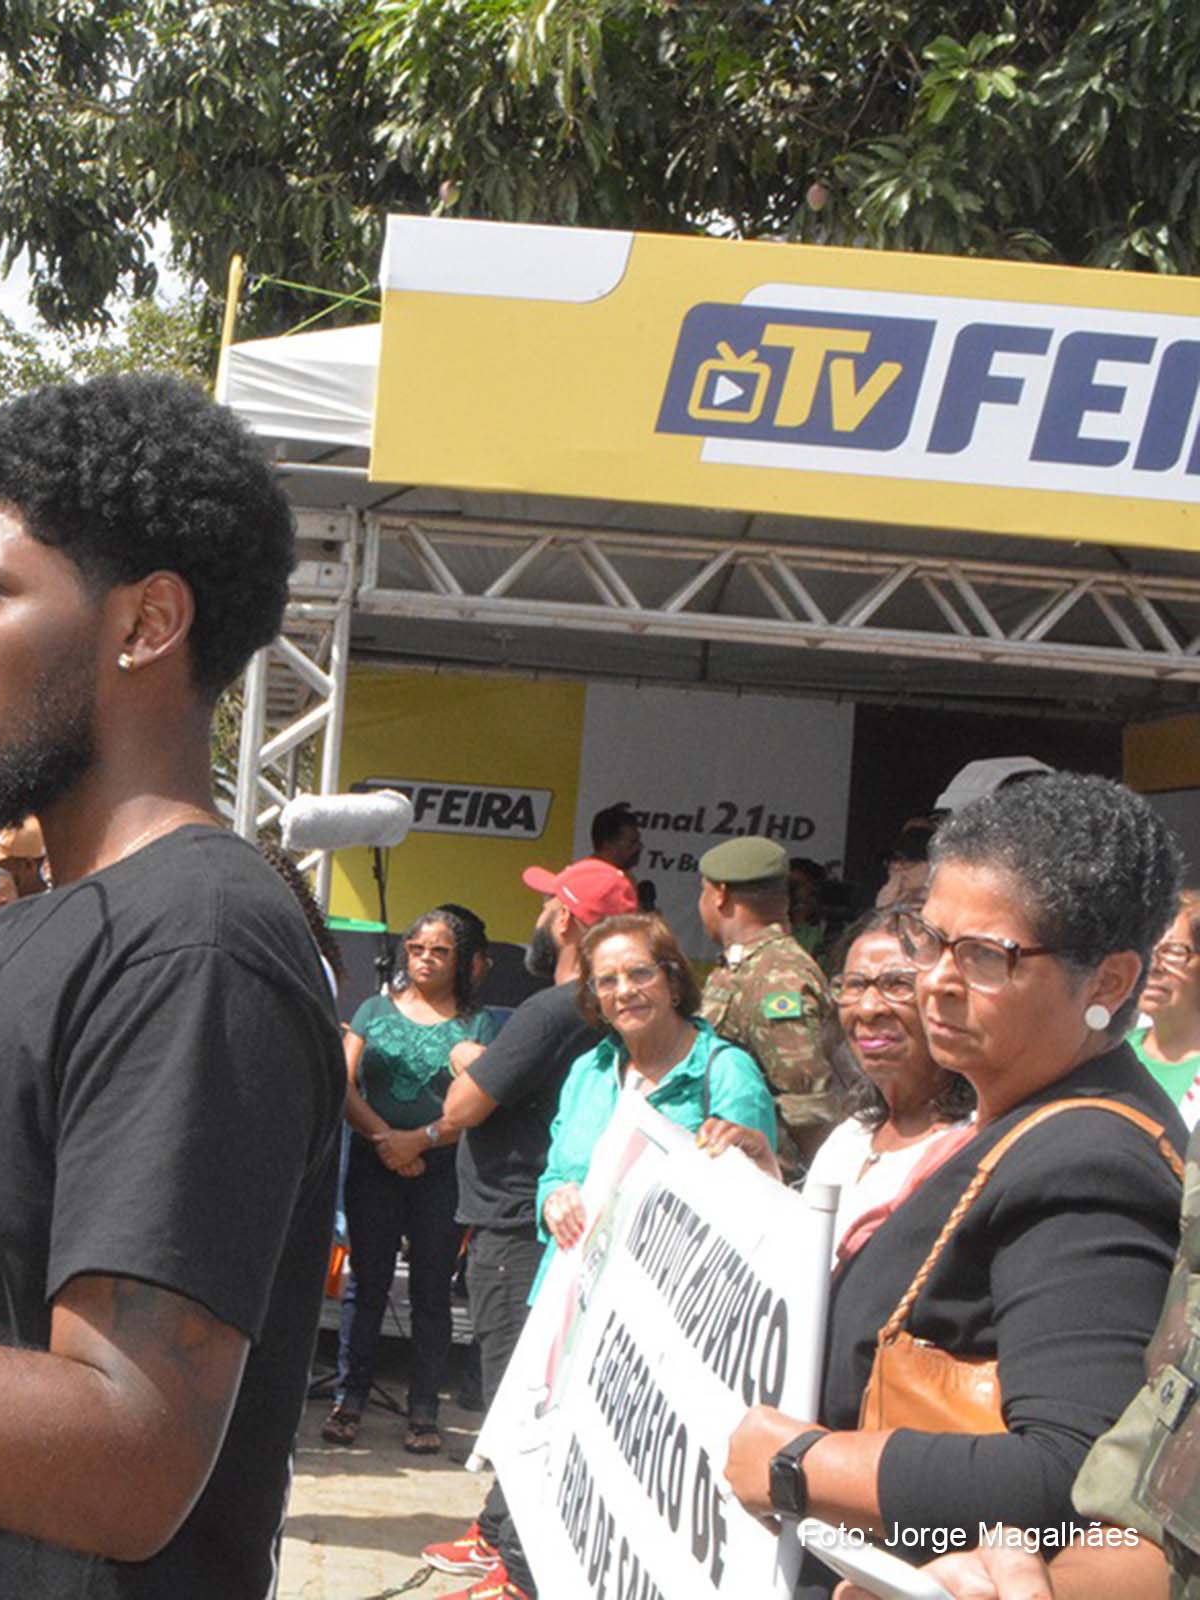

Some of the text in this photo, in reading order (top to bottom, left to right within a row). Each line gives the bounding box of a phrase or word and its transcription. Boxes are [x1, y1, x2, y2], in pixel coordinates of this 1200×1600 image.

[759, 321, 1200, 477] Tv FEI
[412, 787, 537, 832] FEIRA
[556, 1431, 595, 1568] FEIRA
[588, 1494, 616, 1600] DE
[587, 1309, 617, 1387] E
[691, 1445, 728, 1591] DE
